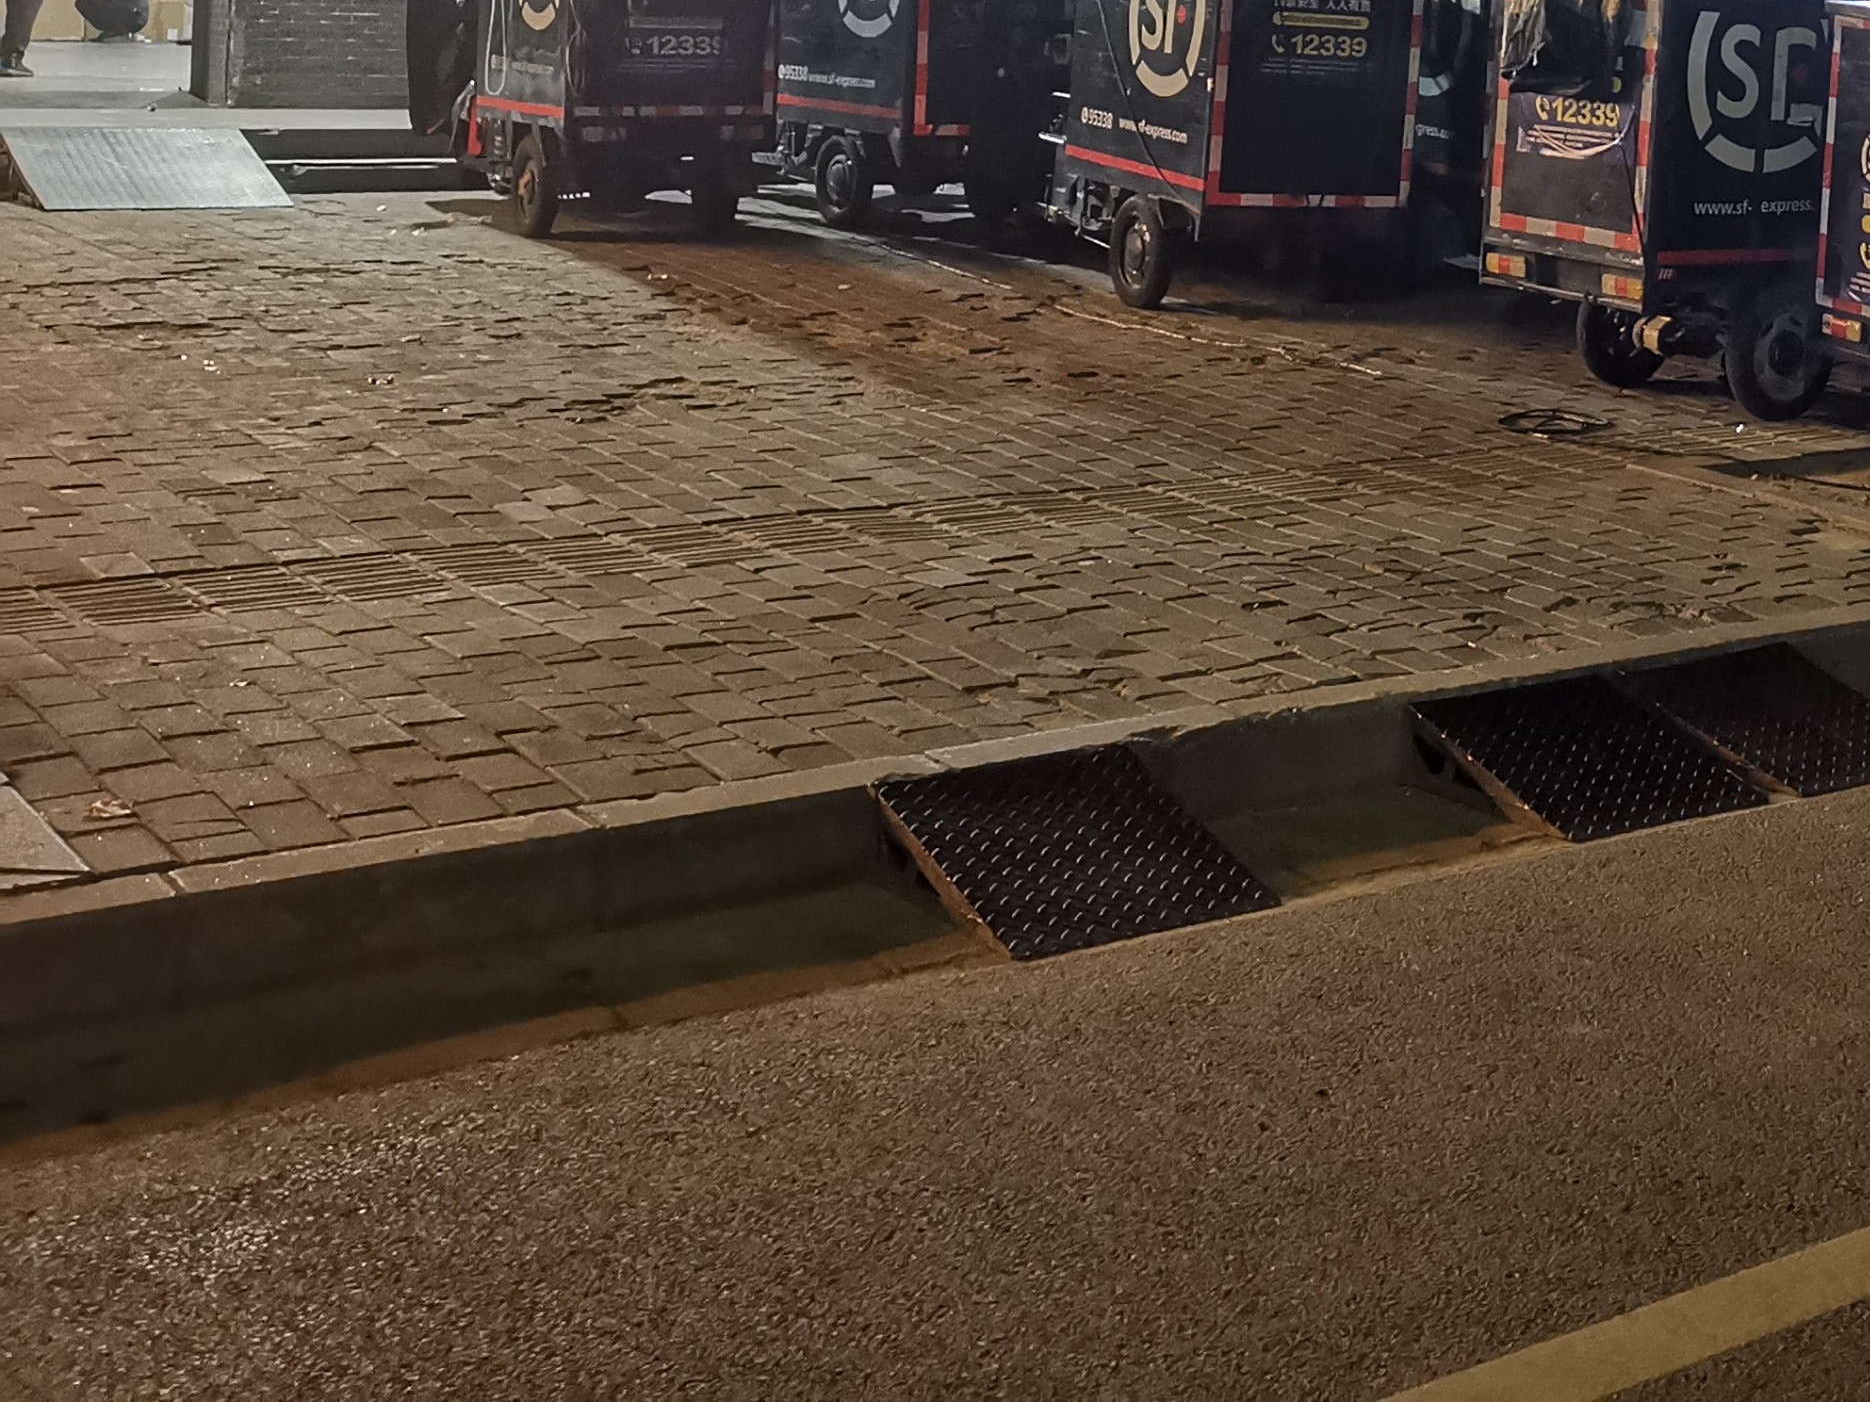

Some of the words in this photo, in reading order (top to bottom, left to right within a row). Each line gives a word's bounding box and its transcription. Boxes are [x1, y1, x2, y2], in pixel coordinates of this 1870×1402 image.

[1290, 34, 1368, 58] 12339
[1551, 96, 1620, 128] 12339
[1118, 118, 1188, 144] wwwsf-express.com
